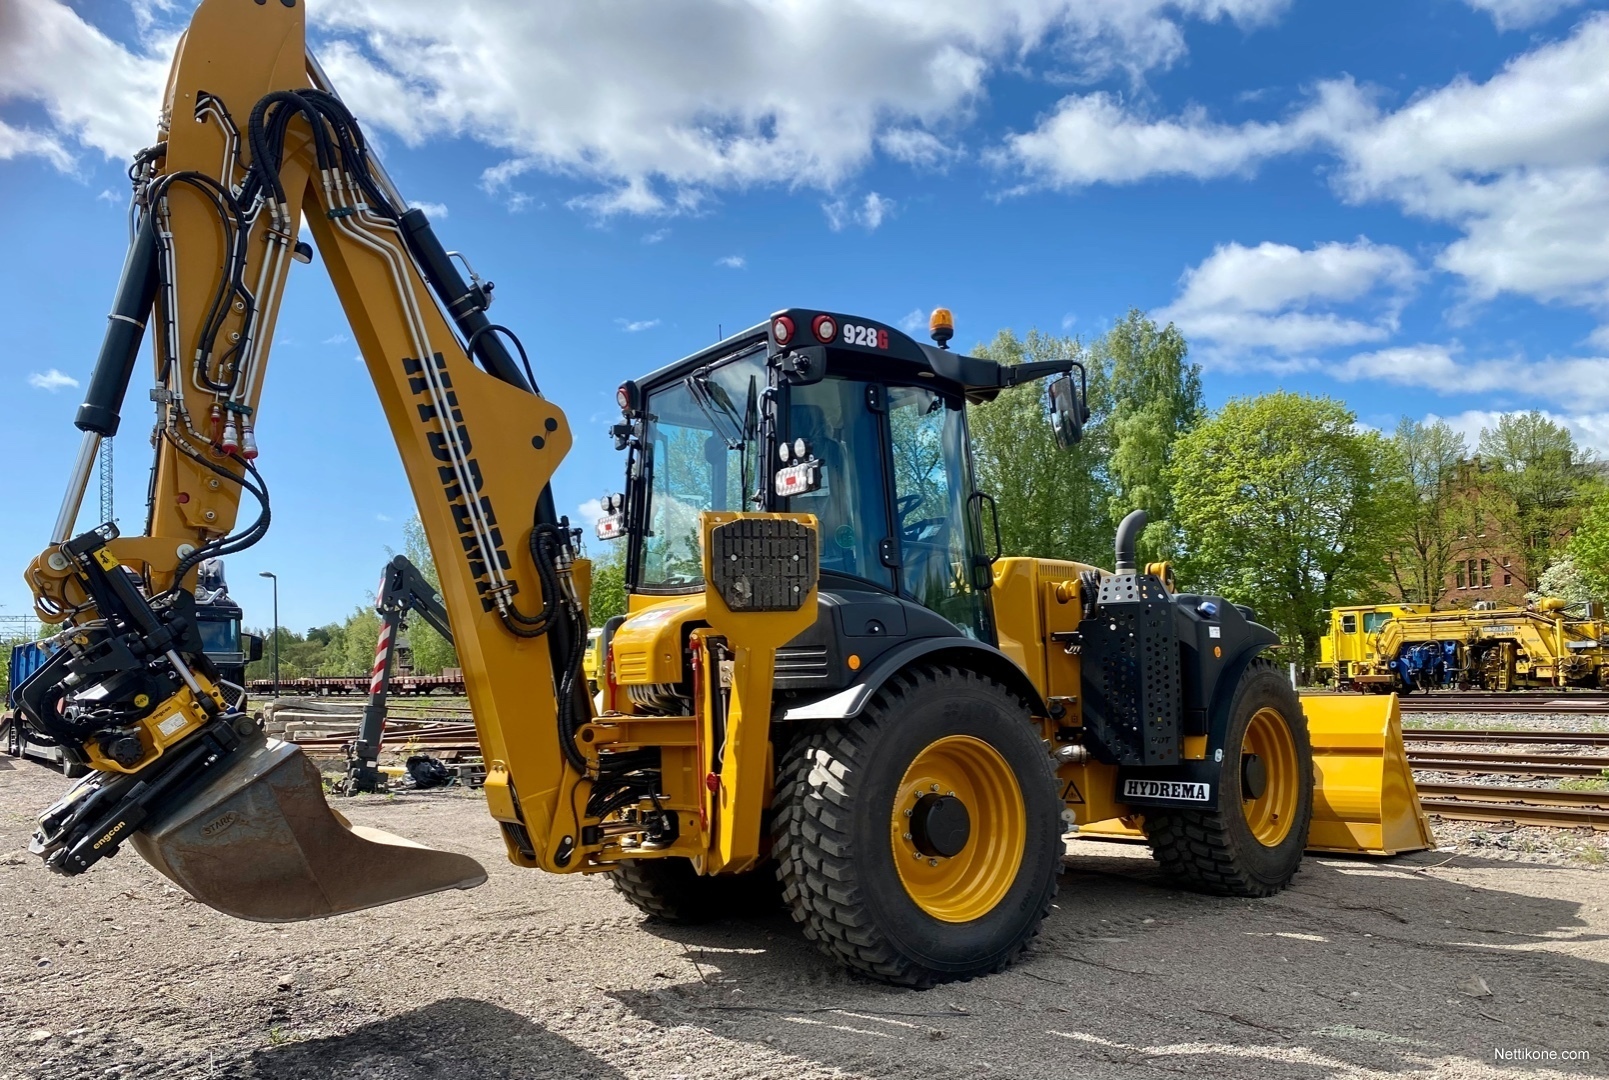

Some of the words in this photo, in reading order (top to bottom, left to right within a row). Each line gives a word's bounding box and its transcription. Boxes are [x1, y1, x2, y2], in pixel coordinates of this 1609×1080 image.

[843, 323, 889, 349] 928G
[152, 706, 172, 720] engcon
[1126, 780, 1206, 800] HYDREMA
[204, 812, 234, 835] STARK
[93, 821, 126, 850] engcon
